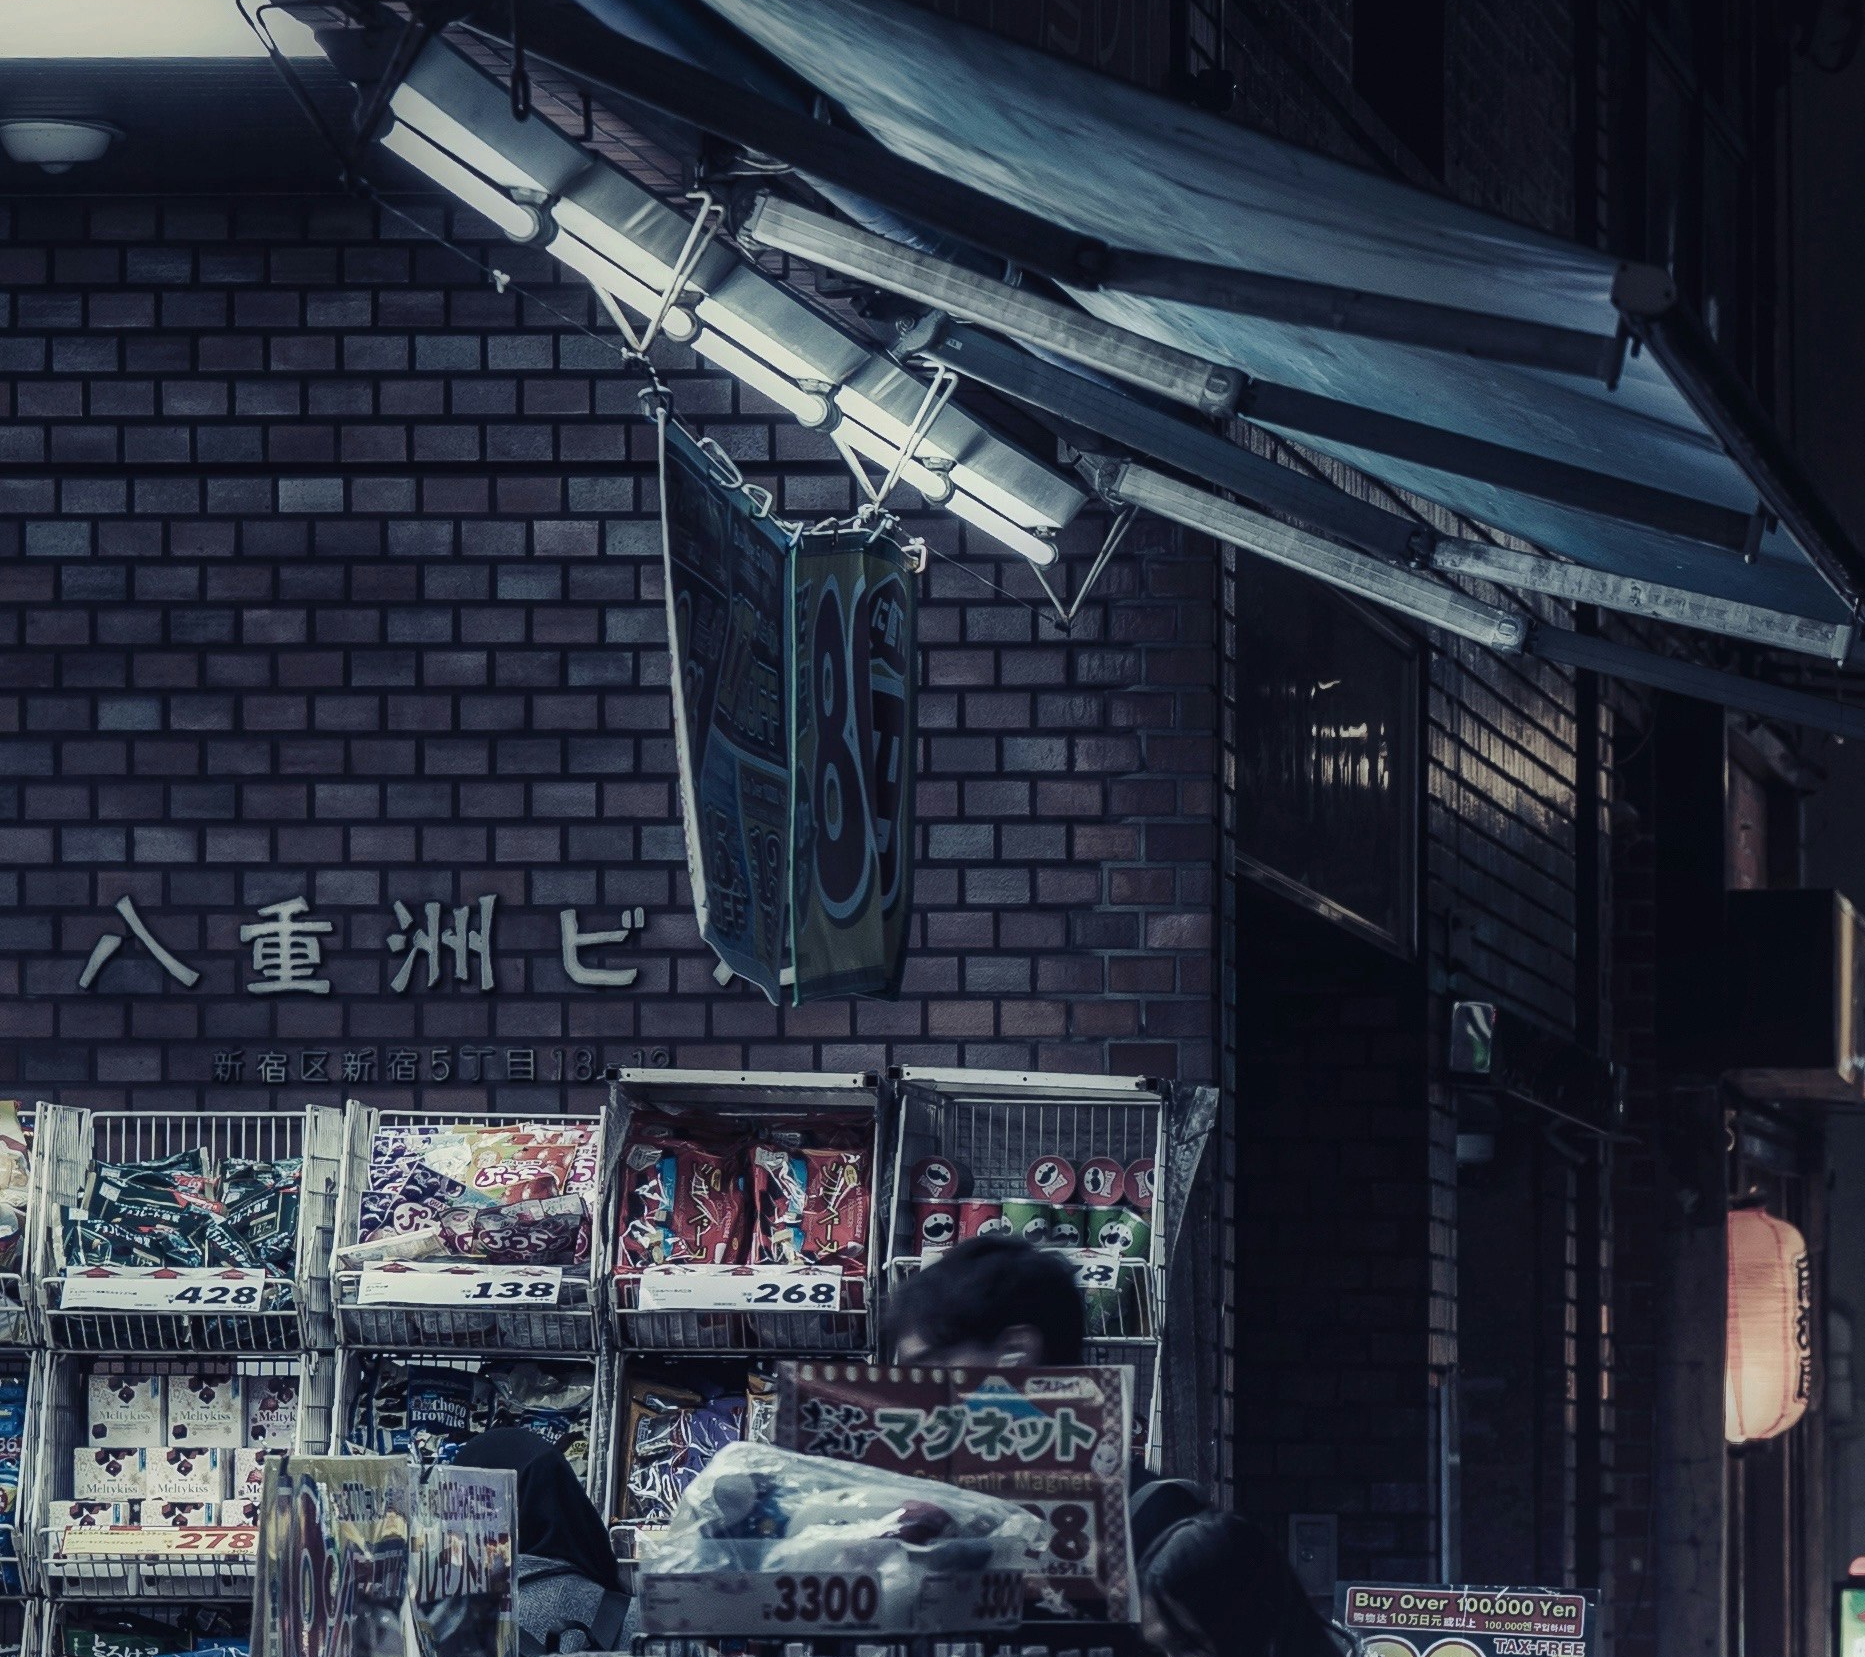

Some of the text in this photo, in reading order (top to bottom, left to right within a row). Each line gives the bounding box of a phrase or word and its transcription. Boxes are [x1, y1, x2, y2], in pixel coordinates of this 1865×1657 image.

[79, 893, 800, 995] 八重洲ビ
[179, 1409, 231, 1422] Meltykiss
[258, 1409, 297, 1423] Meltyk
[411, 1410, 466, 1429] Brownie
[874, 1405, 1097, 1462] マグネット
[86, 1482, 138, 1495] Meltykiss
[157, 1482, 209, 1495] Meltykiss
[1014, 1470, 1092, 1493] Magnet
[175, 1533, 256, 1549] 278
[773, 1574, 880, 1622] 3300
[1355, 1592, 1577, 1618] Buy Over 100,000 Yen
[1494, 1638, 1586, 1657] TAX-FREE
